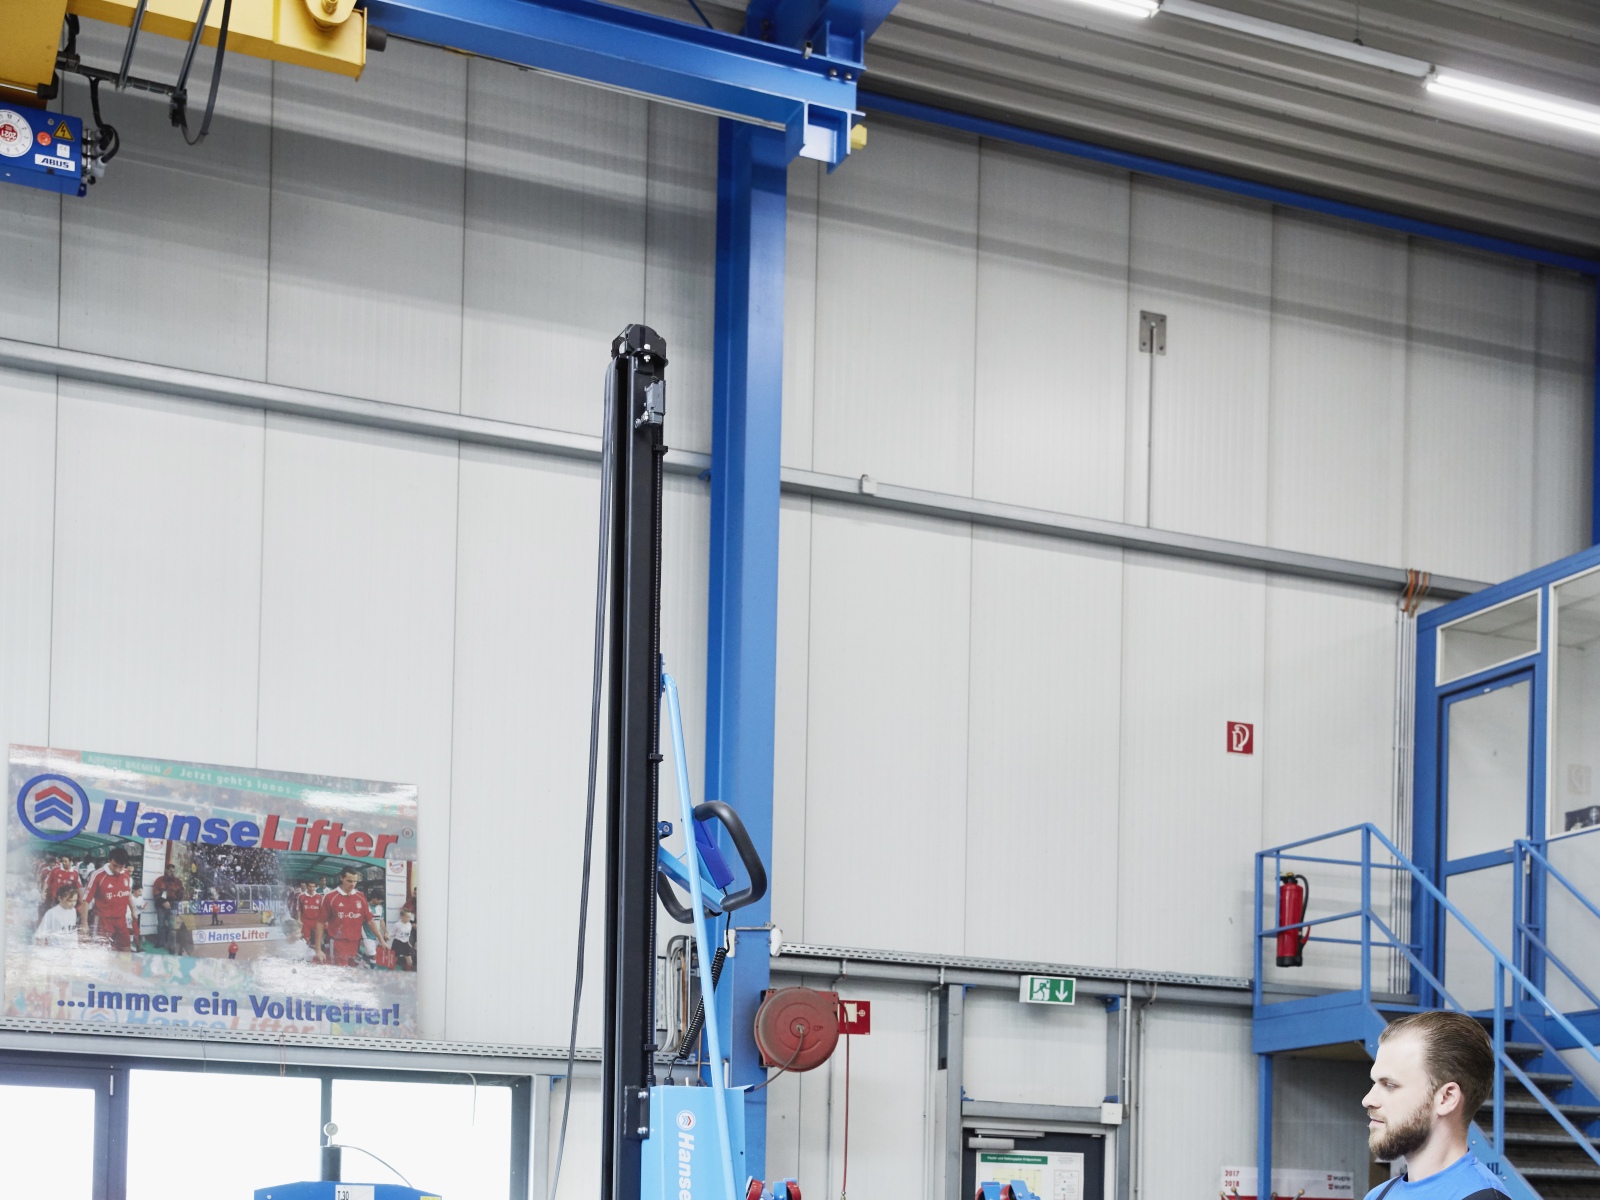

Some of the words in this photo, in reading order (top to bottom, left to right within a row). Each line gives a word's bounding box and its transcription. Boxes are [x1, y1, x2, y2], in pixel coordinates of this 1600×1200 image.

[41, 157, 69, 168] ABUS
[180, 768, 212, 781] Jetzt
[217, 775, 252, 788] geht's
[97, 798, 399, 859] HanseLifter
[208, 930, 269, 941] HanseLifter
[194, 991, 238, 1016] ein
[249, 994, 400, 1027] Volltreffer!
